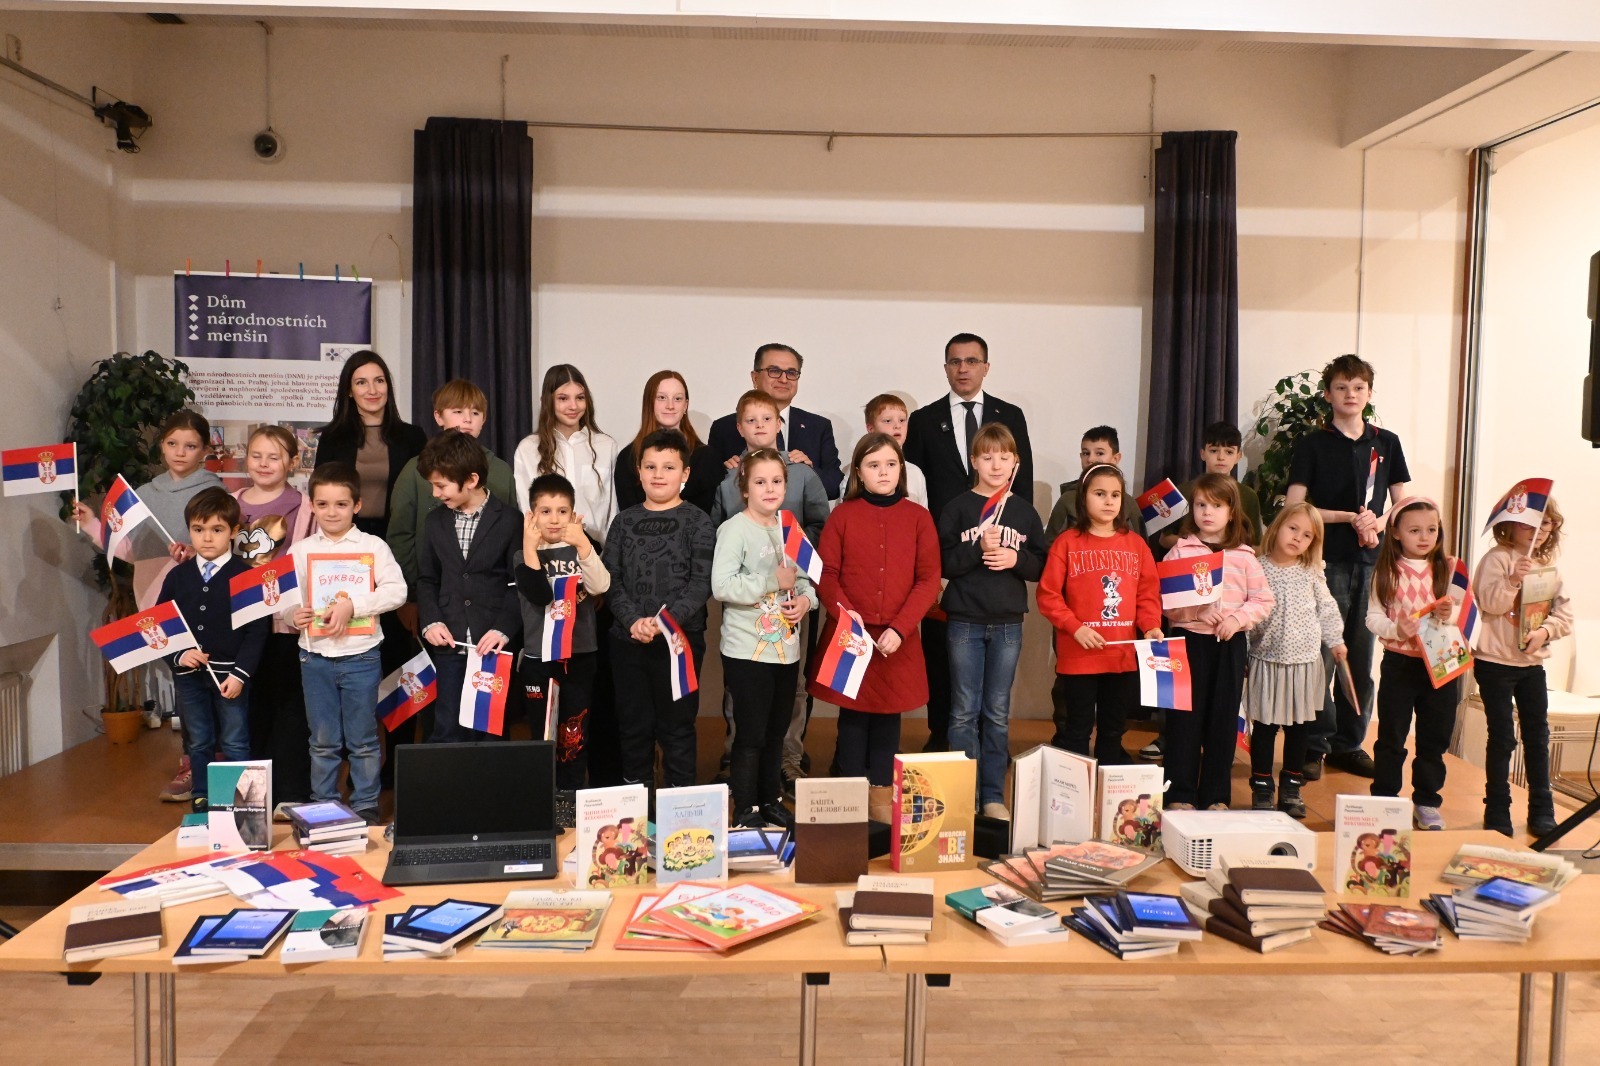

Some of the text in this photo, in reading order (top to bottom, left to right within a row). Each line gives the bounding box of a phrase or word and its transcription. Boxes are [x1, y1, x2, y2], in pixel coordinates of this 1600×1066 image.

[207, 295, 246, 309] Dům
[207, 312, 327, 328] národnostních
[207, 329, 268, 343] menšin
[1068, 549, 1139, 580] MINNIE
[319, 574, 364, 586] Буквар
[938, 854, 965, 863] ЗНАЊЕ
[726, 892, 781, 916] Буквар
